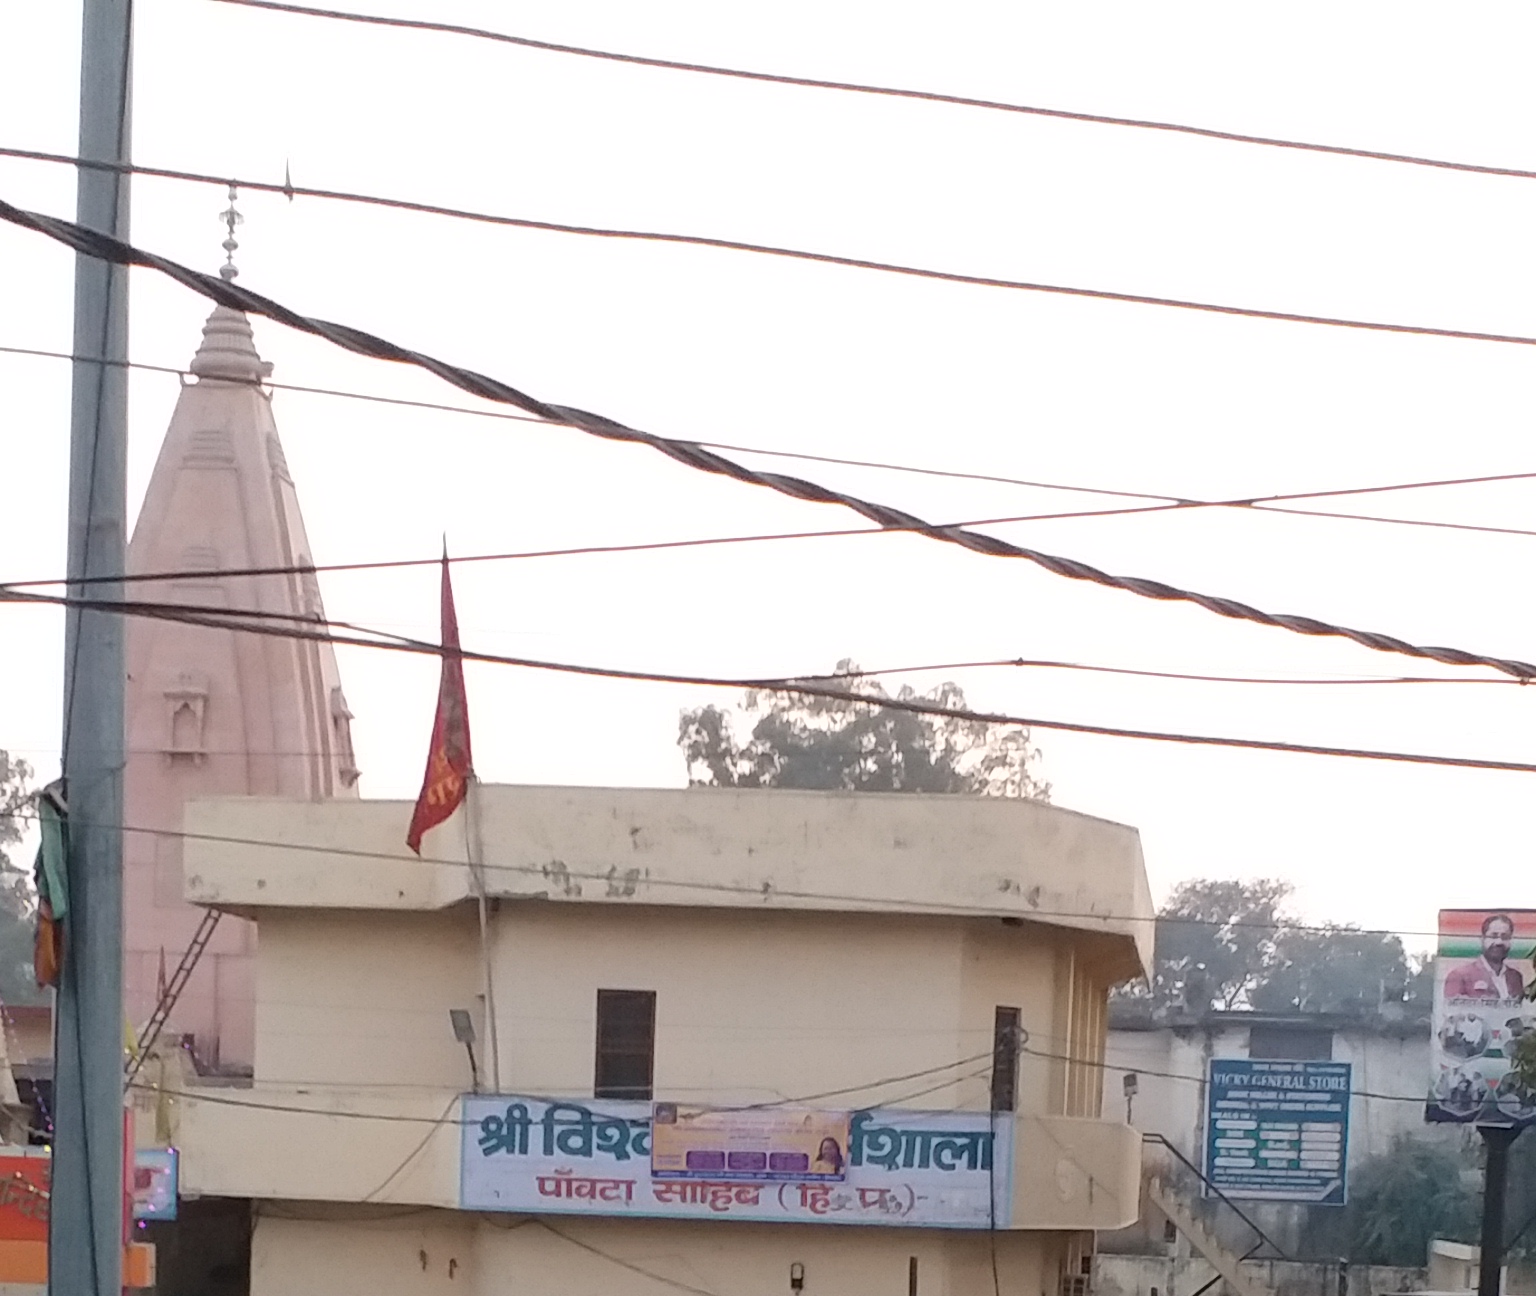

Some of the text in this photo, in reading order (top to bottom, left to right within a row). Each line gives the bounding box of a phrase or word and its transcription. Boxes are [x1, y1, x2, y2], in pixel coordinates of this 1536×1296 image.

[1213, 1072, 1346, 1090] VICKY GENERAL STORE
